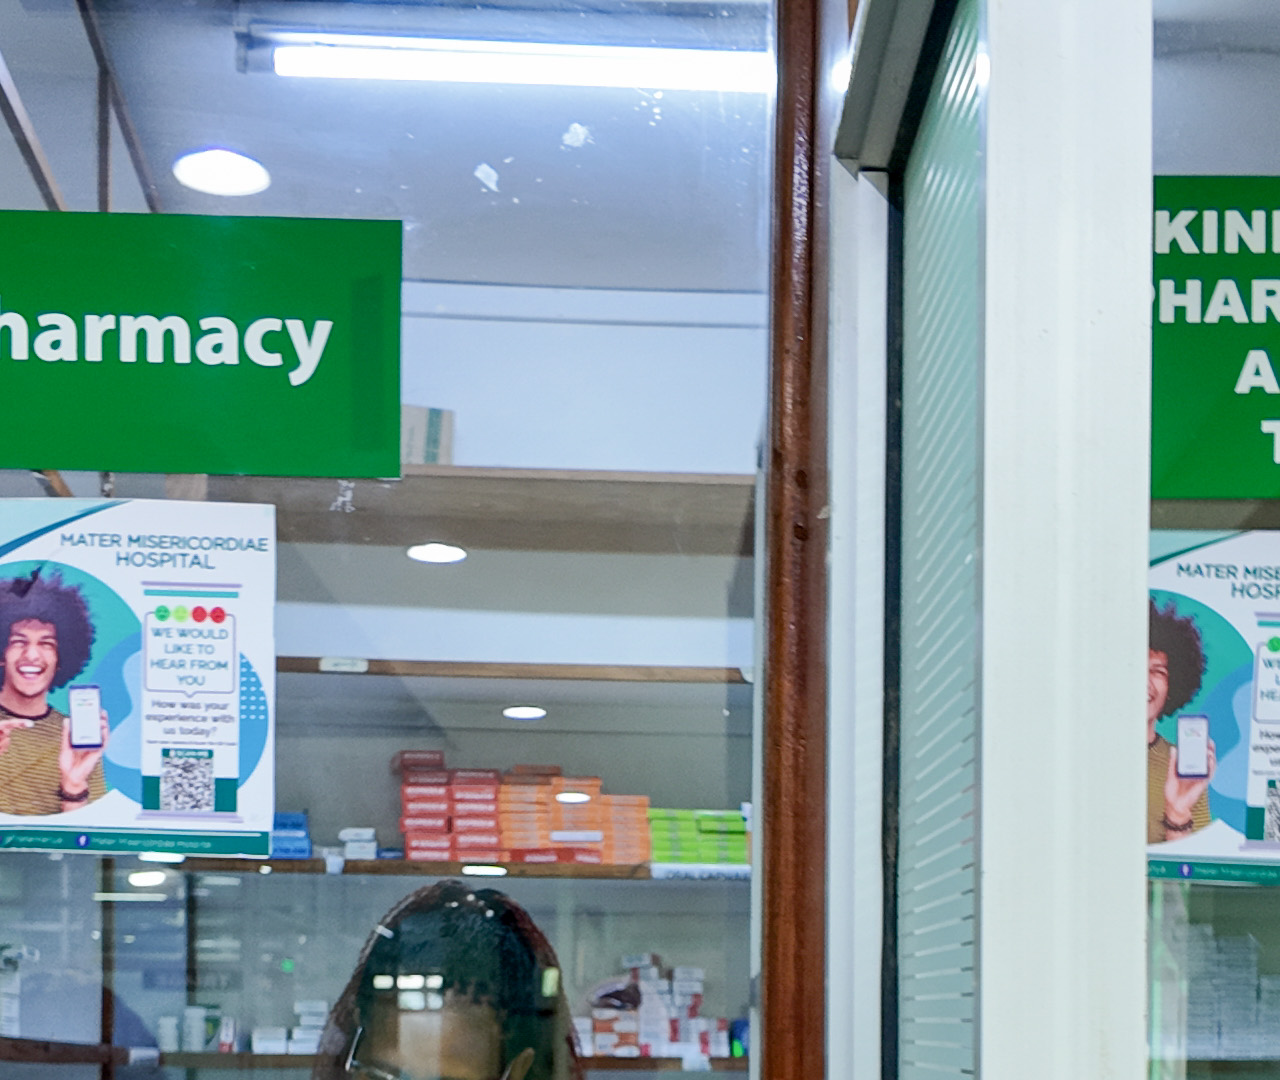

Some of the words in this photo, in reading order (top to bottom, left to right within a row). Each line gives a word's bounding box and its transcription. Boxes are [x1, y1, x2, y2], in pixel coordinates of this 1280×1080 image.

[60, 533, 121, 547] MATER
[127, 534, 269, 551] MISERICORDIAE
[116, 551, 215, 569] HOSPITAL
[1176, 562, 1238, 579] MATER
[151, 627, 173, 638] WE
[177, 627, 229, 640] WOULD
[164, 643, 193, 655] LIKE
[197, 643, 215, 655] TO
[150, 658, 186, 670] HEAR
[190, 659, 228, 671] FROM
[177, 675, 206, 686] YOU
